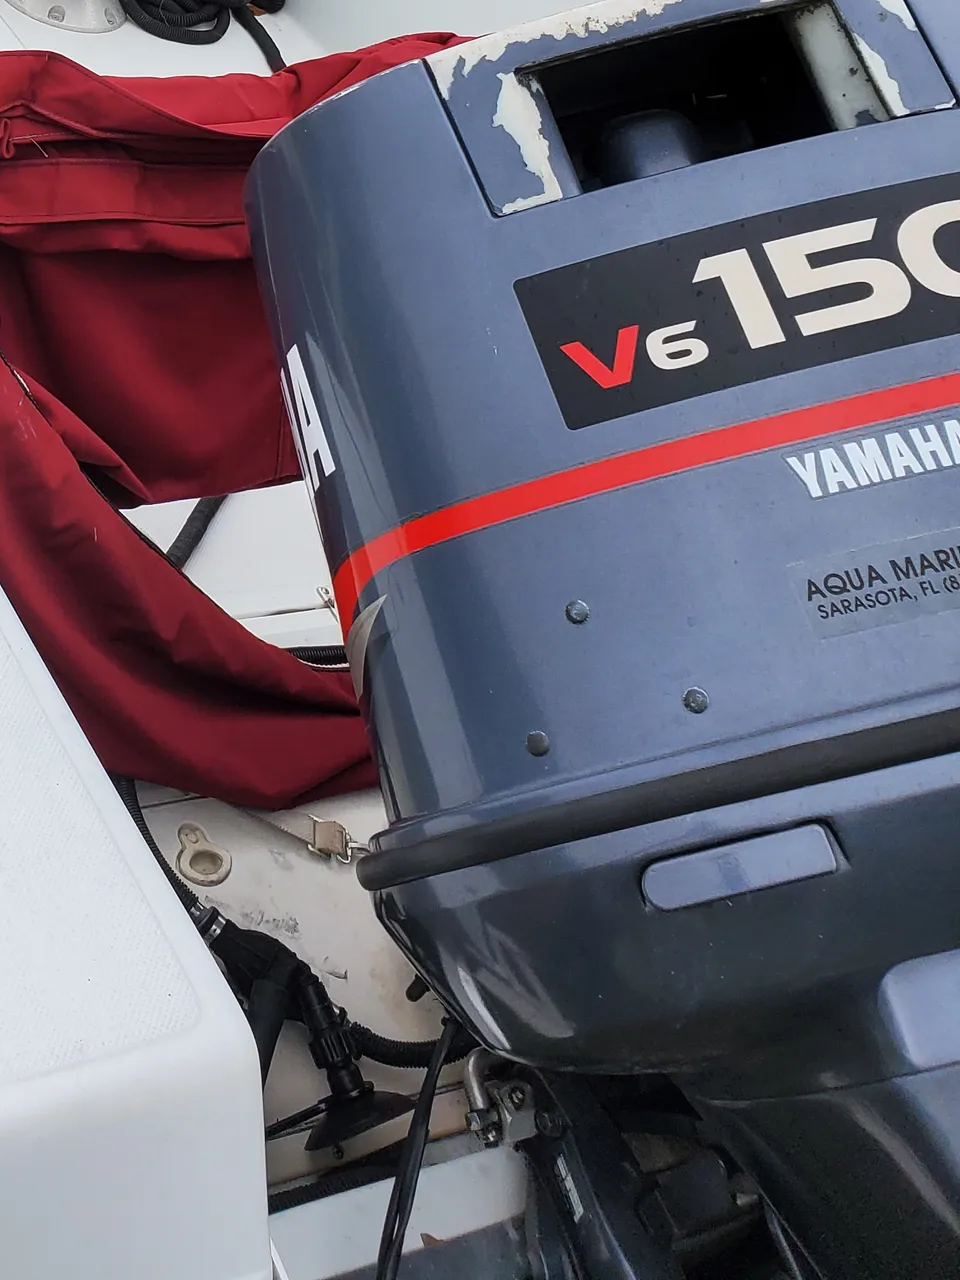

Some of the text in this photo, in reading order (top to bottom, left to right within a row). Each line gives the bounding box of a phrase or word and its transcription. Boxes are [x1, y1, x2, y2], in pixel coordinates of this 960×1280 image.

[559, 320, 710, 389] V6
[807, 545, 960, 602] AQUA MARI
[817, 573, 960, 620] SARASOTA, FL (8
